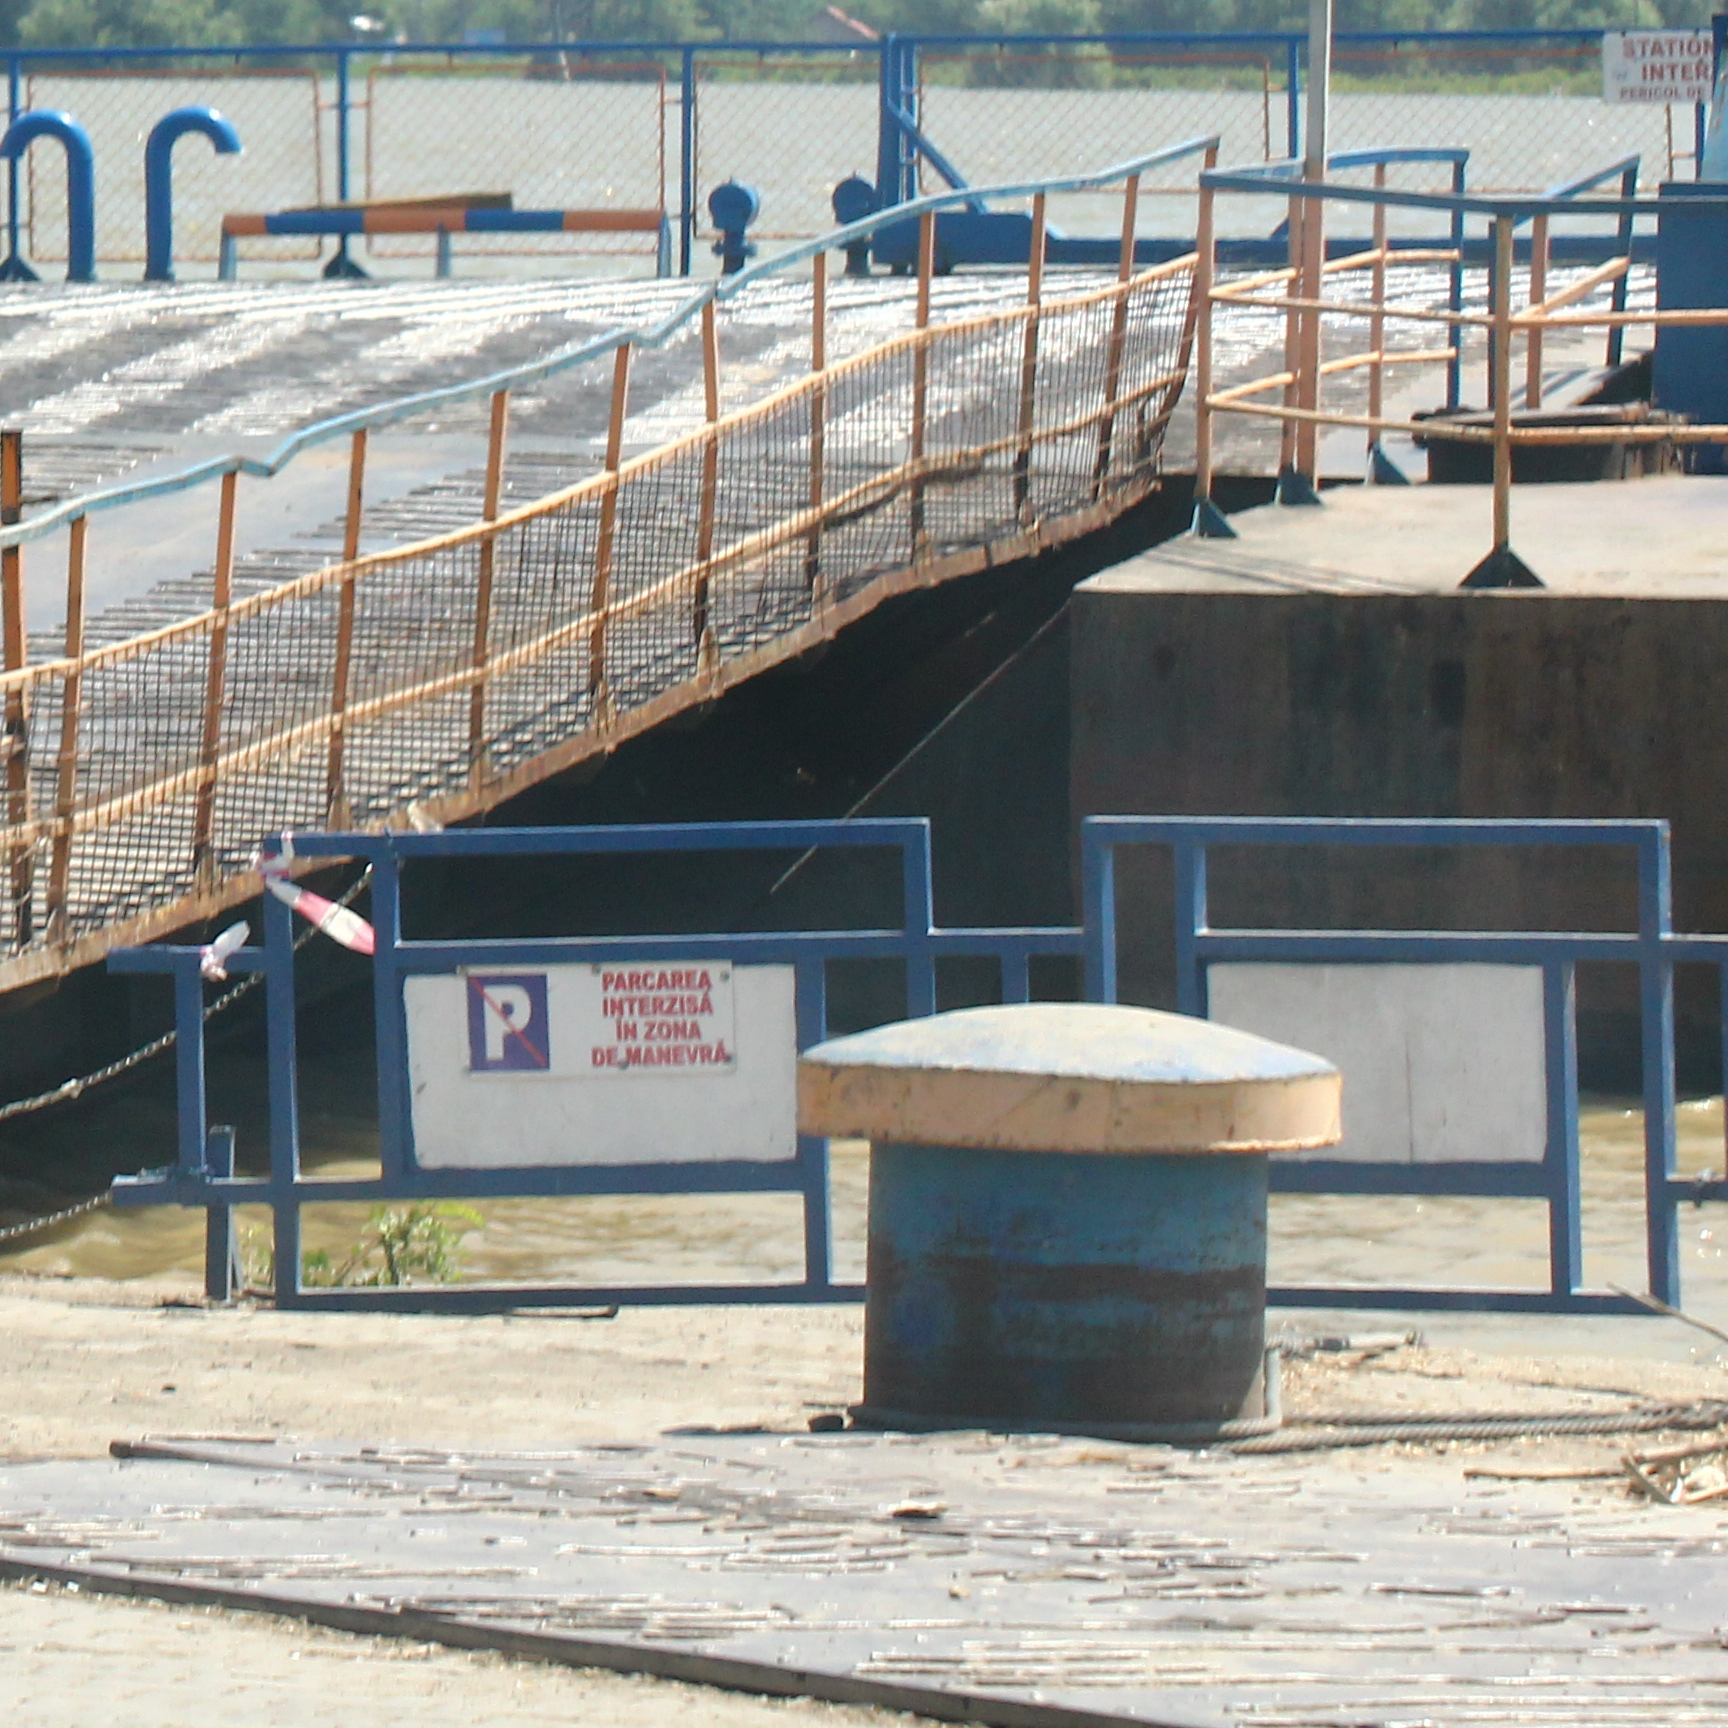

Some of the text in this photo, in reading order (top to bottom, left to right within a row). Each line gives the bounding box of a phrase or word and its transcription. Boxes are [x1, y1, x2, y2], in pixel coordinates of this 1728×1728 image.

[1641, 61, 1713, 82] INTER
[602, 969, 712, 991] PARCAREA
[483, 984, 532, 1062] P
[643, 1019, 701, 1040] ZONA
[591, 1045, 619, 1067] DE
